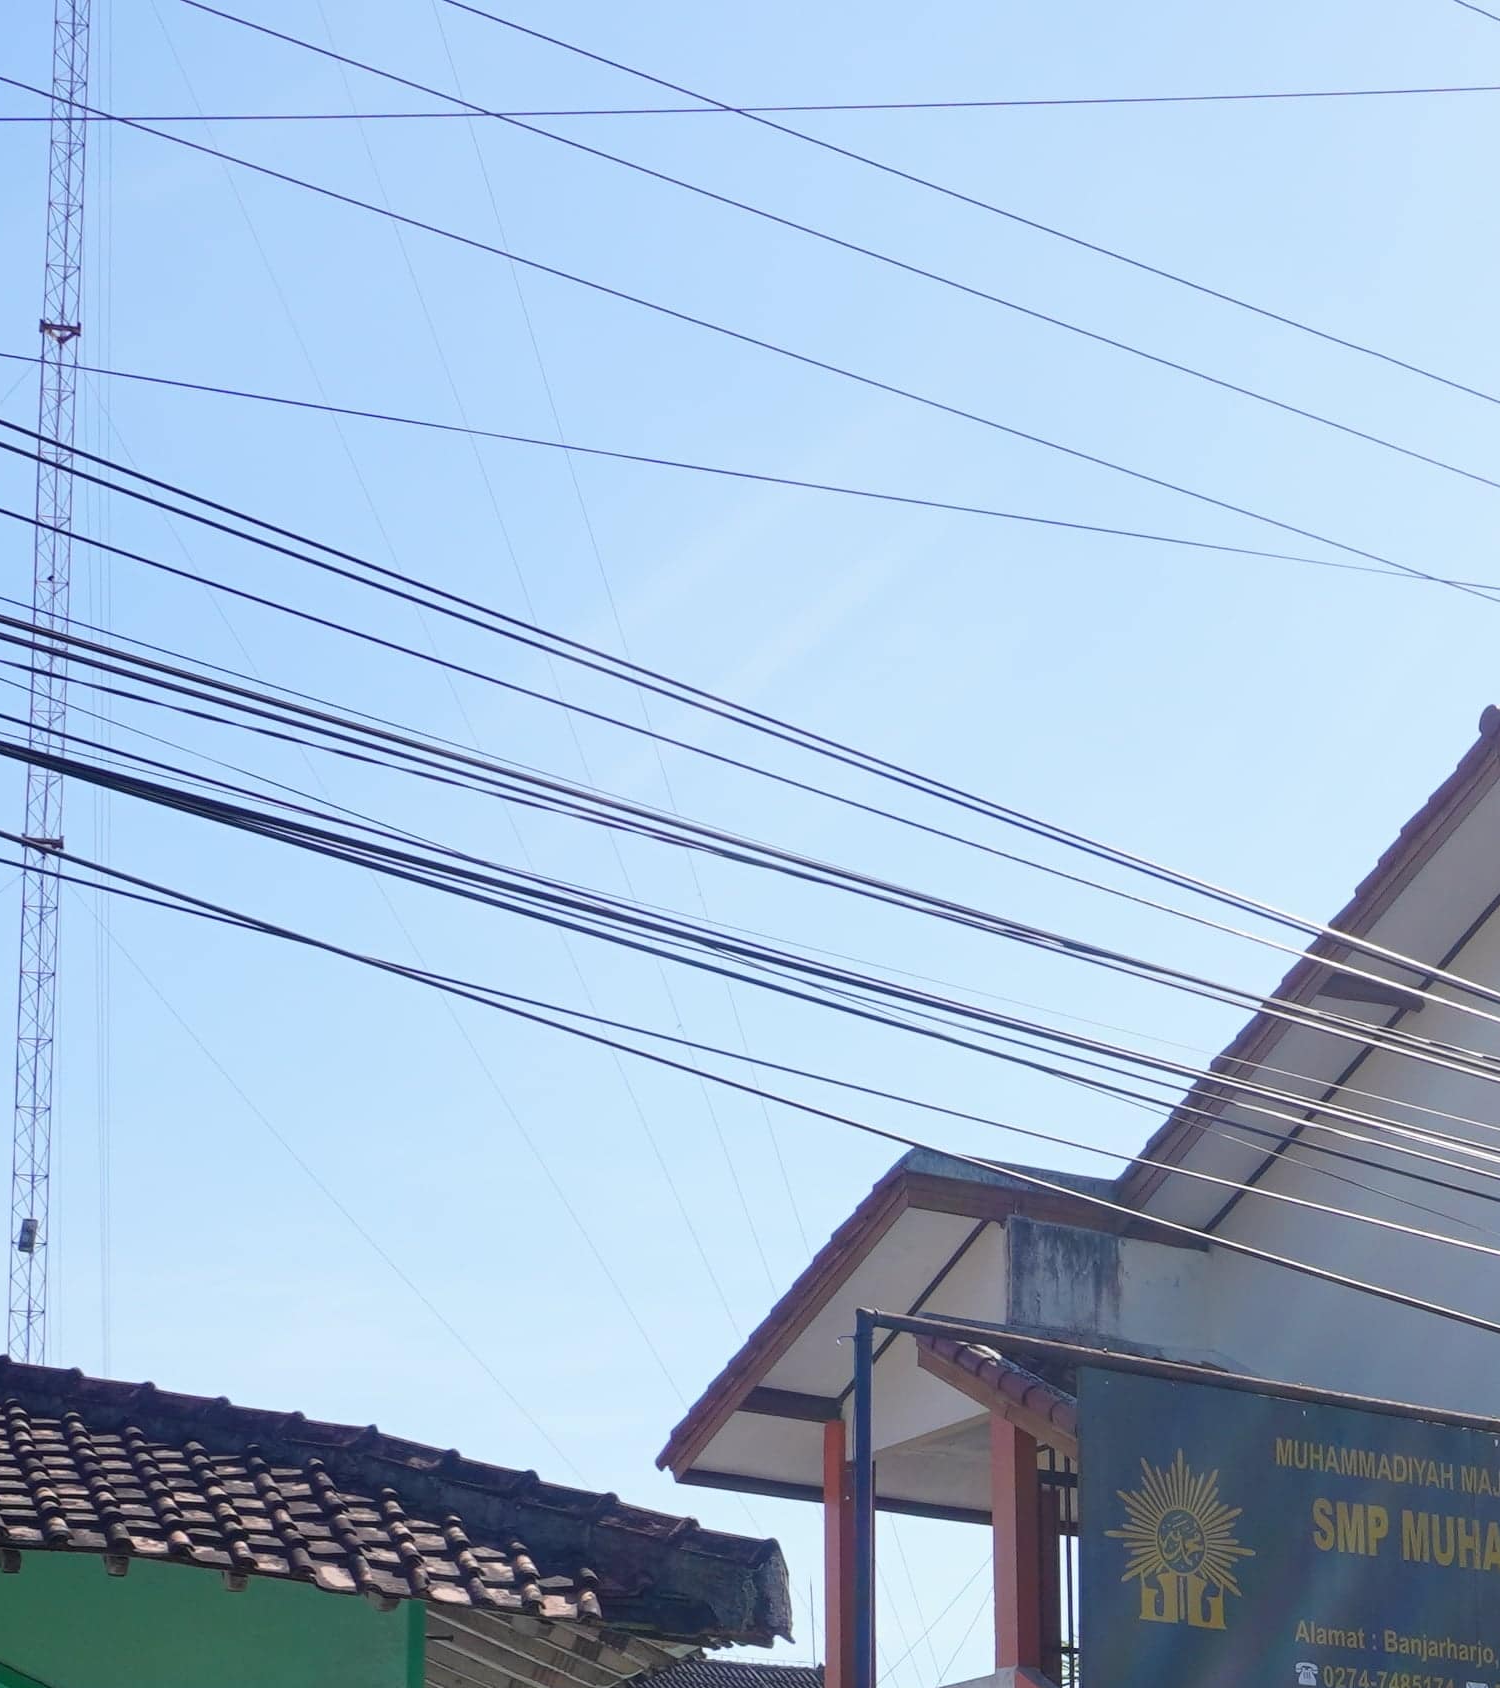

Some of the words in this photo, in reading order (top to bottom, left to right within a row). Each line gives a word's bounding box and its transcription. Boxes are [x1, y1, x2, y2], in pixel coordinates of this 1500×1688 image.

[1275, 1438, 1454, 1491] MUHAMMADIYAH
[1312, 1498, 1388, 1556] SMP
[1295, 1620, 1365, 1649] Alamat
[1384, 1630, 1500, 1669] Banjarharjo,
